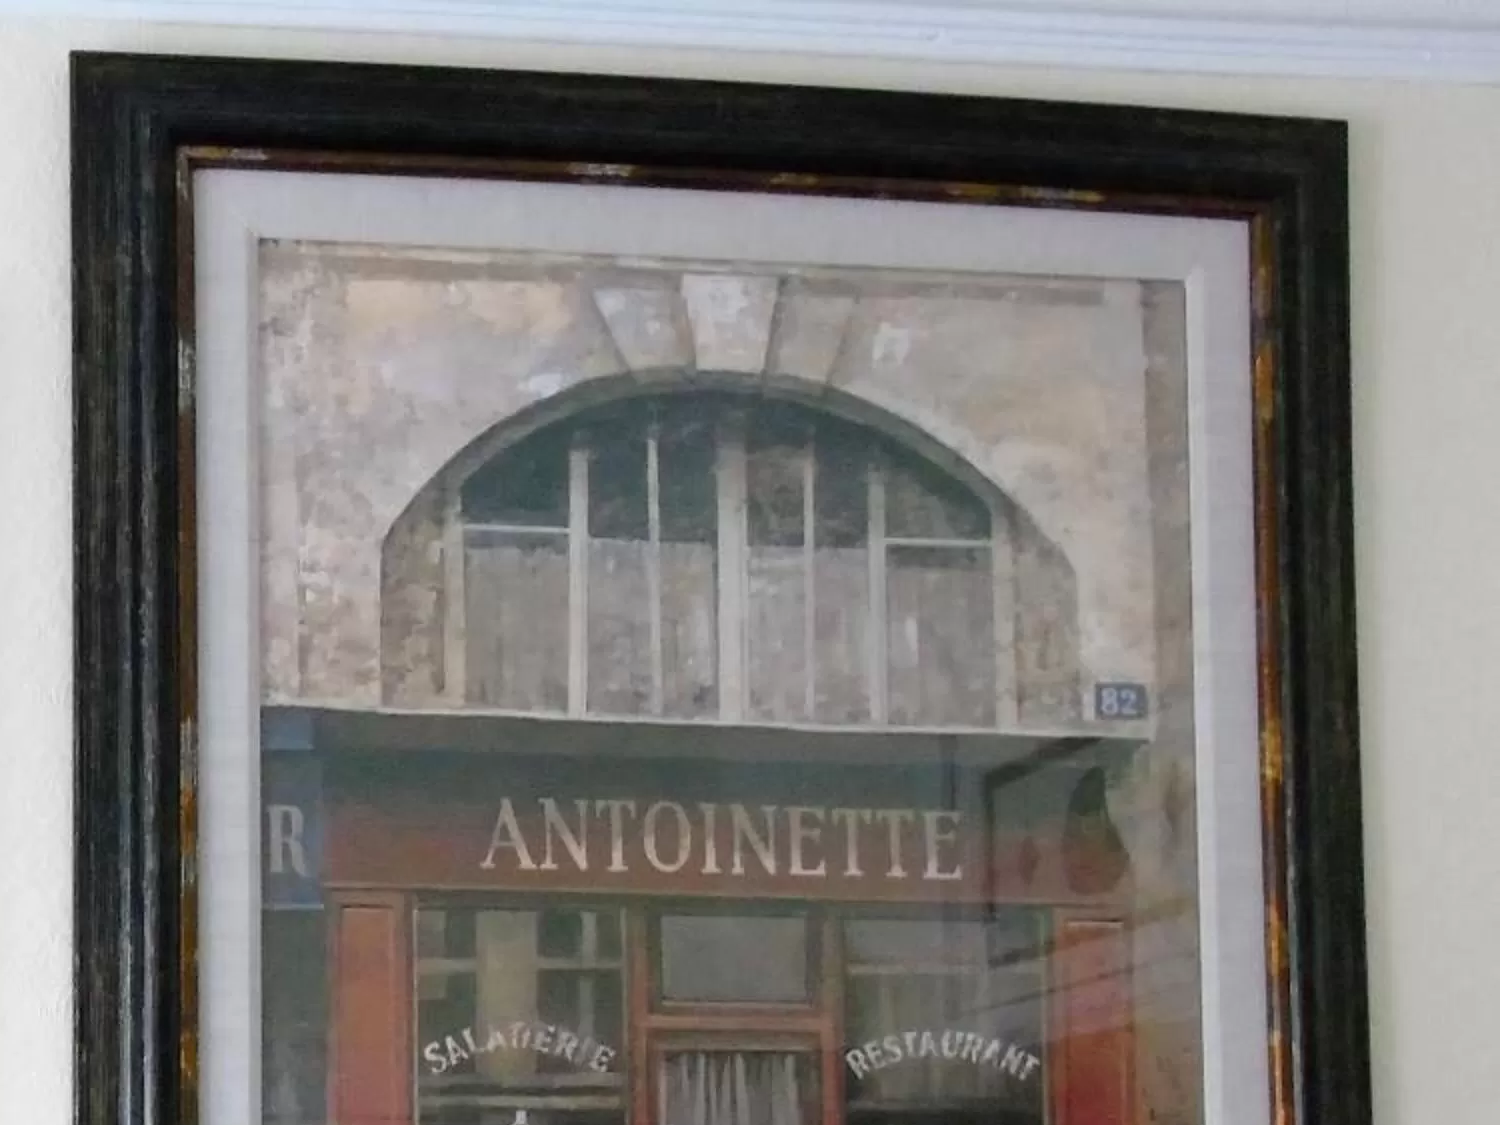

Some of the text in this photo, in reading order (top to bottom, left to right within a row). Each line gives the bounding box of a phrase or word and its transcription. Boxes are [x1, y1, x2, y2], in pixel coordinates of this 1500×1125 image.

[1100, 687, 1137, 716] 82
[266, 803, 306, 878] R
[479, 797, 964, 880] ANTOINETTE
[846, 1030, 1041, 1081] RESTAURANT
